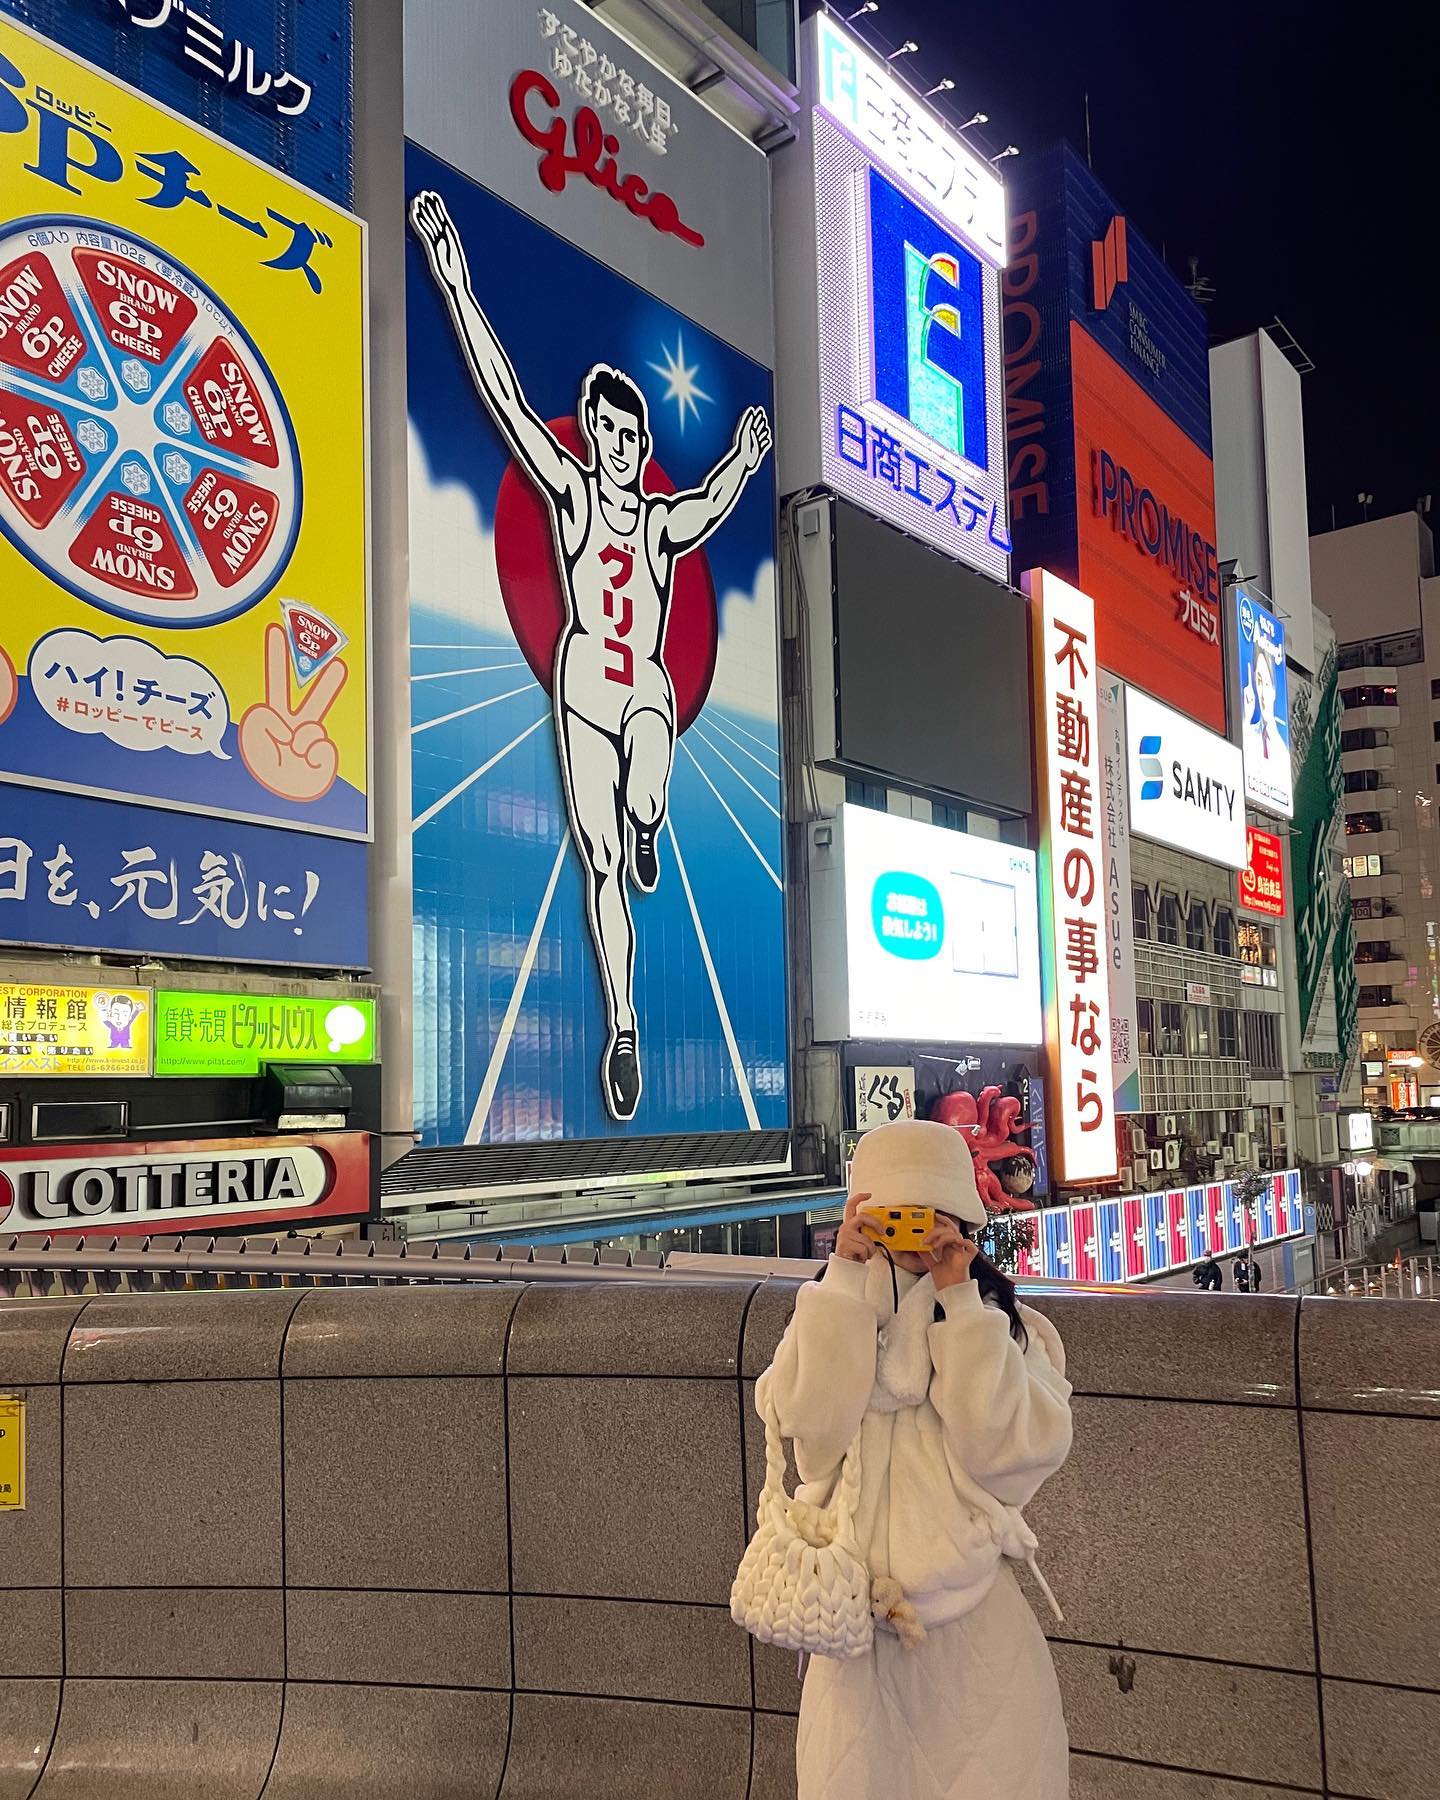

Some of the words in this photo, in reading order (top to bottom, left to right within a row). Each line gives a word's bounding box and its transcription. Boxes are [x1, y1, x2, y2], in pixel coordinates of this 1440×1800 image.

[35, 85, 112, 132] ロッピー
[510, 70, 704, 247] Glico
[96, 260, 179, 314] SNOW
[120, 292, 156, 315] BRAND
[15, 303, 41, 335] BRAND
[22, 315, 66, 359] 6P
[109, 301, 163, 342] 6P
[47, 334, 83, 377] CHEESE
[111, 330, 161, 361] CHEESE
[187, 386, 217, 440] CHEESE
[203, 379, 233, 438] 6P
[220, 362, 271, 448] SNOW
[223, 388, 243, 427] BRAND
[0, 418, 42, 501] SNO
[13, 428, 39, 471] BRAND
[26, 415, 62, 480] 6P
[46, 413, 81, 471] CHEESE
[186, 473, 217, 514] CHEESE
[838, 403, 1013, 553] 日商エステム
[110, 496, 161, 523] CHEESE
[202, 488, 238, 530] 6P
[223, 510, 244, 539] BRAND
[1098, 448, 1218, 604] PROMISE
[108, 514, 163, 552] 6P
[116, 543, 153, 561] BRAND
[222, 501, 268, 575] SNOW
[90, 547, 175, 590] SNOW
[297, 615, 331, 641] SNOW
[598, 543, 636, 687] グリコ
[1178, 589, 1220, 646] プロミス
[299, 632, 321, 651] 6P
[44, 662, 216, 720] ハイ!チーズ
[56, 697, 204, 741] #ロッピーでピース
[1104, 754, 1118, 849] 株式会社
[1172, 760, 1235, 822] SAMTY
[1053, 616, 1104, 1133] 不動産の事なら
[20, 987, 87, 998] CORPORATION
[164, 1007, 226, 1043] 賃貸・売買
[231, 1003, 318, 1050] ピタットハウス
[160, 1057, 246, 1066] http://www.pitat.com/
[867, 1074, 905, 1121] くくる
[1022, 1078, 1029, 1111] 2F
[33, 1156, 305, 1220] LOTTERIA
